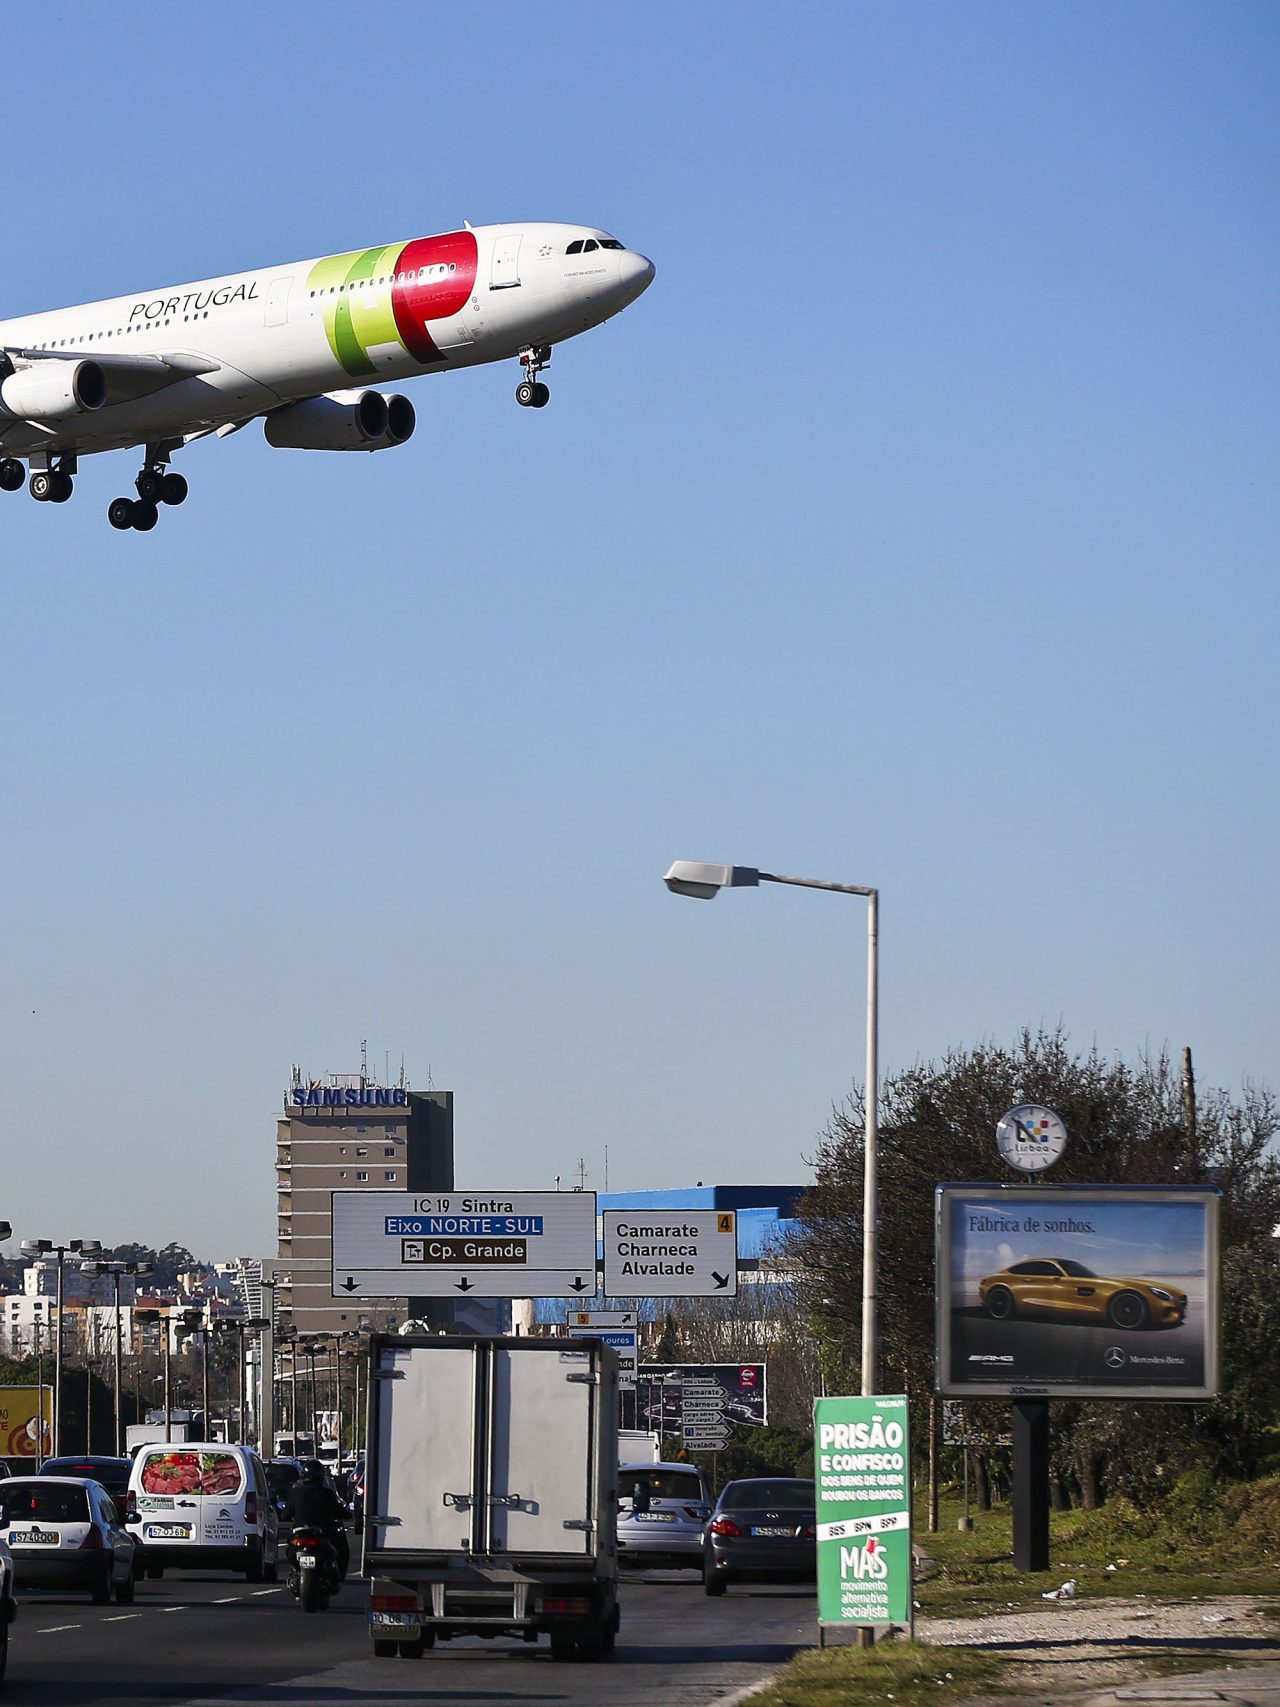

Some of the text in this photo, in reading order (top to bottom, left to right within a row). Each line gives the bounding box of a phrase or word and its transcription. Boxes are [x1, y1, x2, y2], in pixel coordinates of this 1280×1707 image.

[129, 281, 259, 322] PORTUGAL
[292, 1088, 406, 1105] SAMSUNG
[414, 1199, 513, 1213] IC 19 Sintra
[387, 1219, 422, 1233] Eixo
[721, 1215, 730, 1230] 4
[969, 1215, 1096, 1233] Fábrica de sonhos.
[616, 1223, 699, 1237] Camarate
[429, 1243, 523, 1259] Cp. Grande
[617, 1242, 698, 1256] Charneca
[622, 1261, 695, 1275] Alvalade
[580, 1315, 586, 1323] 5
[0, 1408, 9, 1420] AO
[820, 1414, 903, 1450] PRISÃO
[685, 1441, 717, 1449] Alvalade
[820, 1453, 904, 1472] E CONFISCO
[820, 1475, 840, 1487] DOS
[840, 1475, 864, 1487] BENS
[864, 1474, 877, 1486] DE
[821, 1489, 904, 1501] ROUBOU OS BANCOS
[829, 1525, 845, 1536] BES
[854, 1521, 872, 1532] BPN
[841, 1580, 888, 1591] movimento
[841, 1592, 889, 1603] alternativa
[841, 1604, 889, 1619] socialista
